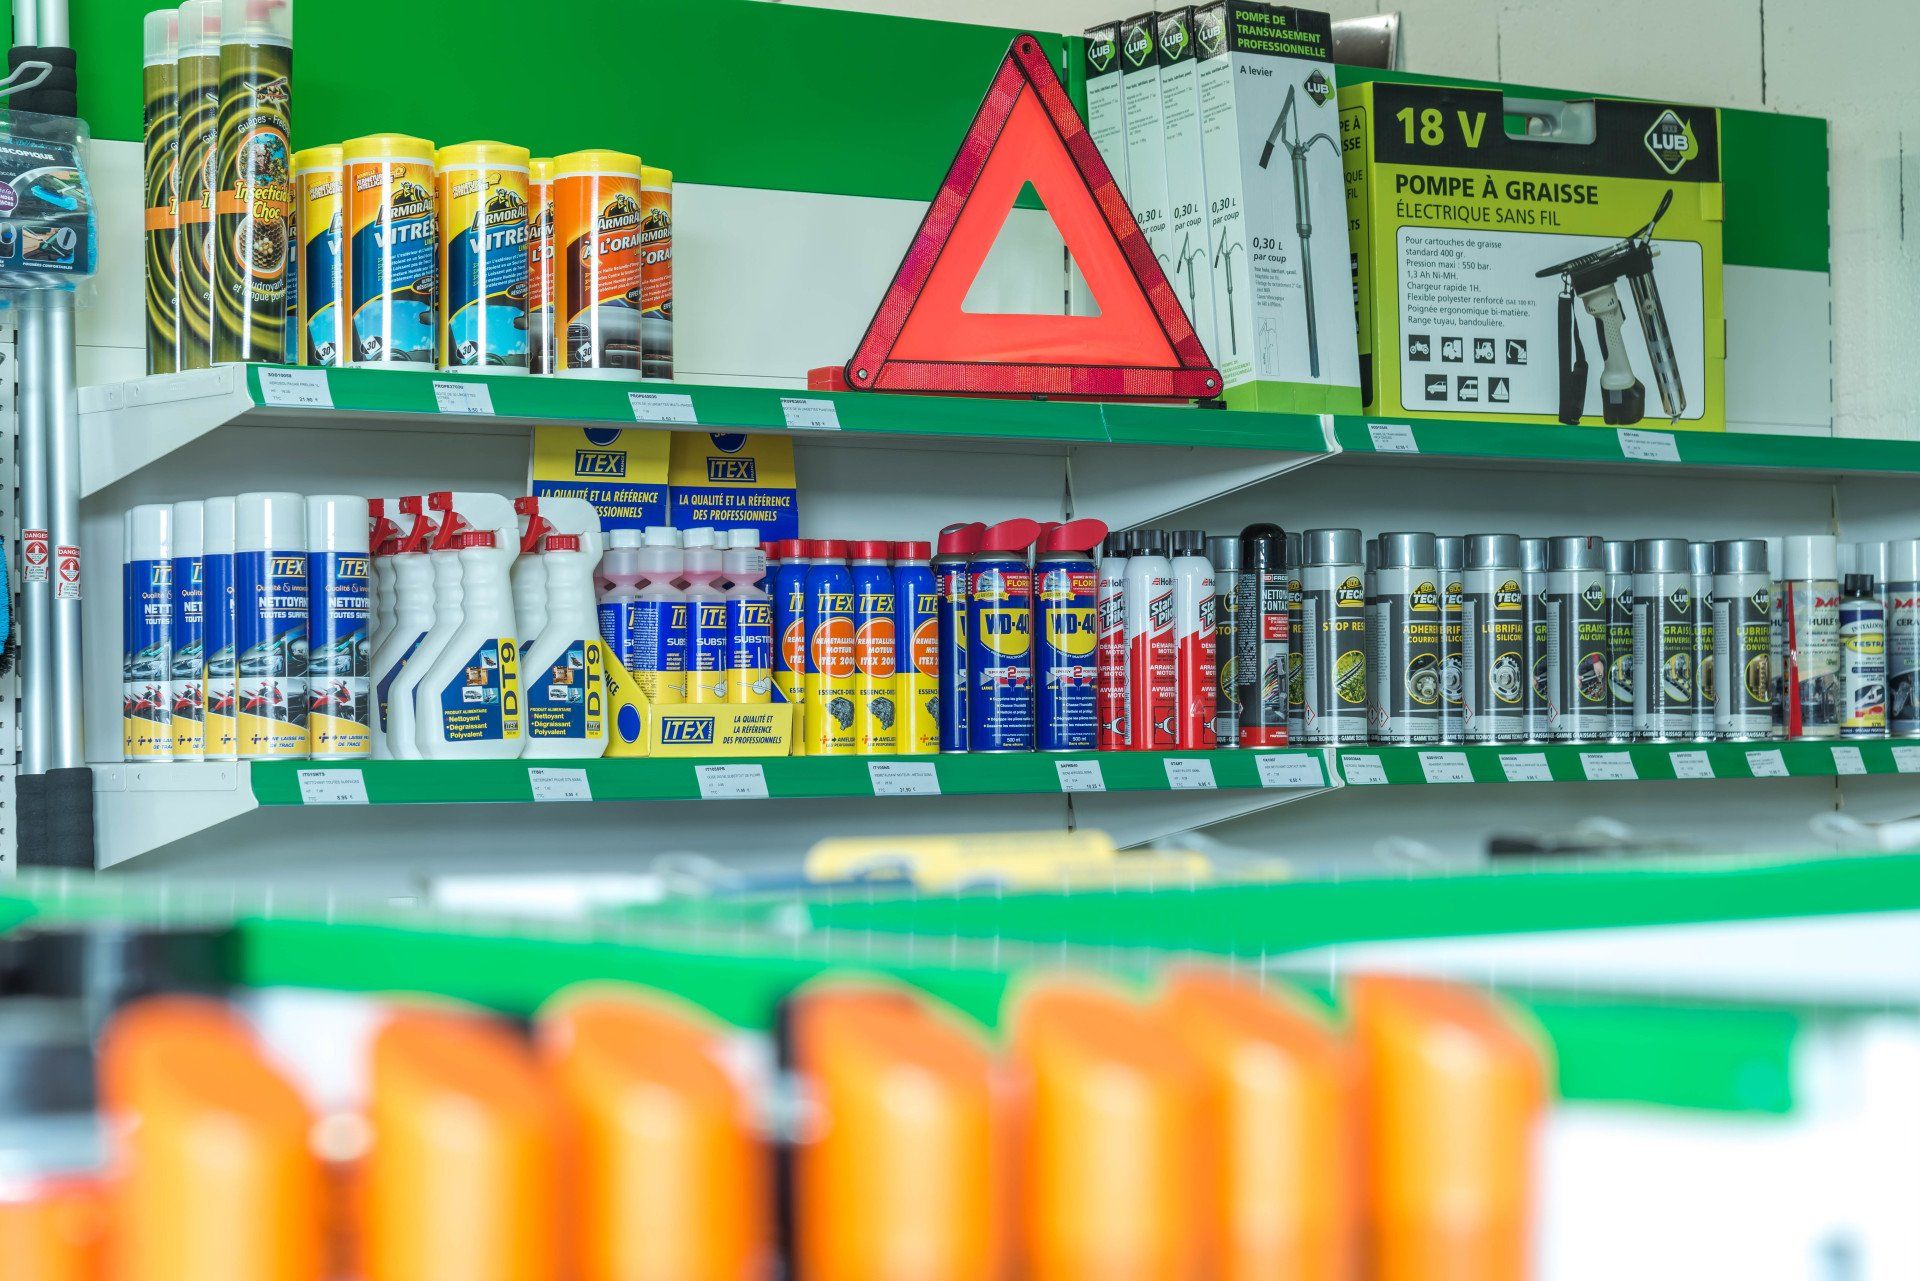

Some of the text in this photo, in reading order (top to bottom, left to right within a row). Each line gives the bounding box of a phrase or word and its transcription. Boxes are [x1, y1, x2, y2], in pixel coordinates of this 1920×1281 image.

[1235, 11, 1286, 25] POMPE DE
[1202, 26, 1220, 40] LUB
[1236, 24, 1321, 43] TRANSVASEMENT
[1129, 40, 1147, 53] LUB
[1164, 34, 1183, 47] LUB
[1092, 45, 1110, 58] LUB
[1237, 38, 1326, 57] PROFESSIONNELLE
[1240, 66, 1273, 77] A levier
[1307, 82, 1330, 94] LUB
[1396, 106, 1487, 148] 18 V
[1652, 132, 1689, 151] LUB
[0, 146, 55, 161] SCOPIQUE
[1396, 174, 1599, 206] POMPE À GRAISSE
[1174, 203, 1193, 219] 0,30
[1212, 197, 1230, 214] 0,30
[252, 200, 281, 225] Choc
[1137, 209, 1157, 225] 0,30
[1397, 199, 1562, 227] ÉLECTRIQUE SANS FIL
[1174, 217, 1202, 236] par coup
[1213, 211, 1241, 232] par coup
[1150, 223, 1166, 235] coup
[1253, 237, 1284, 252] 0,30 L
[1405, 236, 1502, 250] Pour cartouches de graisse
[1253, 254, 1287, 265] par coup
[1405, 248, 1466, 260] standard 400 gr.
[1406, 259, 1436, 268] Pression
[1438, 260, 1457, 269] maxi
[1463, 261, 1476, 270] 550
[1478, 261, 1492, 271] bar.
[1407, 271, 1459, 281] 1,3 Ah Ni-MH.
[1407, 282, 1481, 294] Chargeur rapide 1H.
[1408, 293, 1504, 306] Flexible polyester renforcé
[1408, 305, 1531, 318] Poignée ergonomique bi-matière.
[1408, 316, 1504, 328] Range tuyau, bandoulière.
[322, 346, 331, 357] 30
[368, 340, 377, 351] 30
[465, 345, 475, 356] 30
[577, 452, 621, 474] ITEX
[711, 459, 752, 482] ITEX
[541, 488, 660, 504] LA QUALITÉ ET LA RÉFÉRENCE
[680, 493, 792, 508] LA QUALITÉ ET LA RÉFÉRENCE
[693, 508, 778, 523] DES PROFESSIONNELS
[271, 559, 304, 577] ITEX
[340, 560, 369, 577] ITEX
[1007, 579, 1029, 587] FLOR
[1586, 591, 1603, 600] LUB
[819, 595, 854, 612] ITEX
[860, 596, 895, 612] ITEX
[260, 612, 287, 620] TOUTES
[330, 611, 355, 620] TOUTES
[1403, 624, 1438, 635] ADHERE
[1482, 624, 1522, 635] LUBRIFIA
[1578, 623, 1605, 633] GRAISS
[821, 656, 836, 666] ITEX
[861, 656, 878, 666] ITEX
[1007, 666, 1016, 678] 2
[1074, 666, 1082, 678] 2
[502, 642, 518, 716] DT9
[587, 644, 600, 717] DT9
[449, 715, 481, 726] Nettoyant
[534, 713, 565, 724] Nettoyant
[734, 713, 774, 725] LA QUALITÉ ET
[449, 723, 488, 736] Dégraissant
[534, 720, 572, 732] Dégraissant
[665, 720, 709, 742] ITEX
[733, 724, 772, 735] LA RÉFÉRENCE
[450, 733, 484, 743] Polyvalent
[535, 729, 567, 739] Polyvalent
[723, 735, 782, 746] DES PROFESSIONNELS
